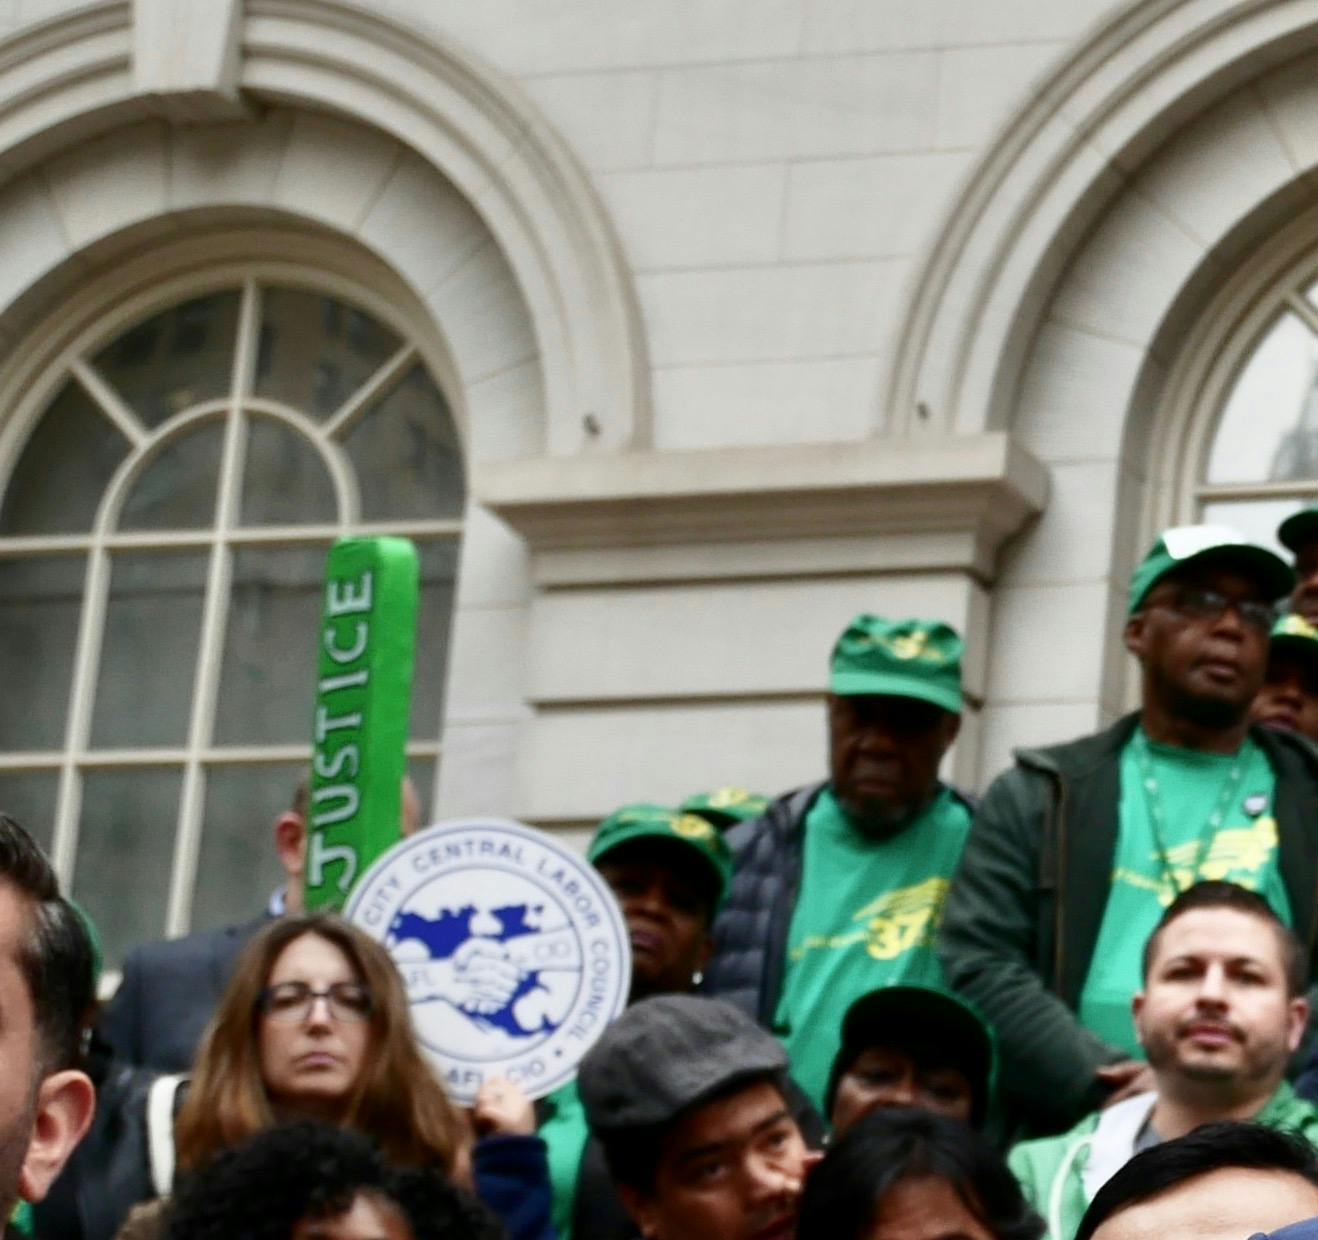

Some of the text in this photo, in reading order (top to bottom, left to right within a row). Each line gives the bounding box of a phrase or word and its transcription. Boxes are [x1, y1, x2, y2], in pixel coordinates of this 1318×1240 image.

[309, 570, 373, 893] JUSTICE
[364, 839, 609, 1042] CITY CENTRAL LABOR COUNCIL
